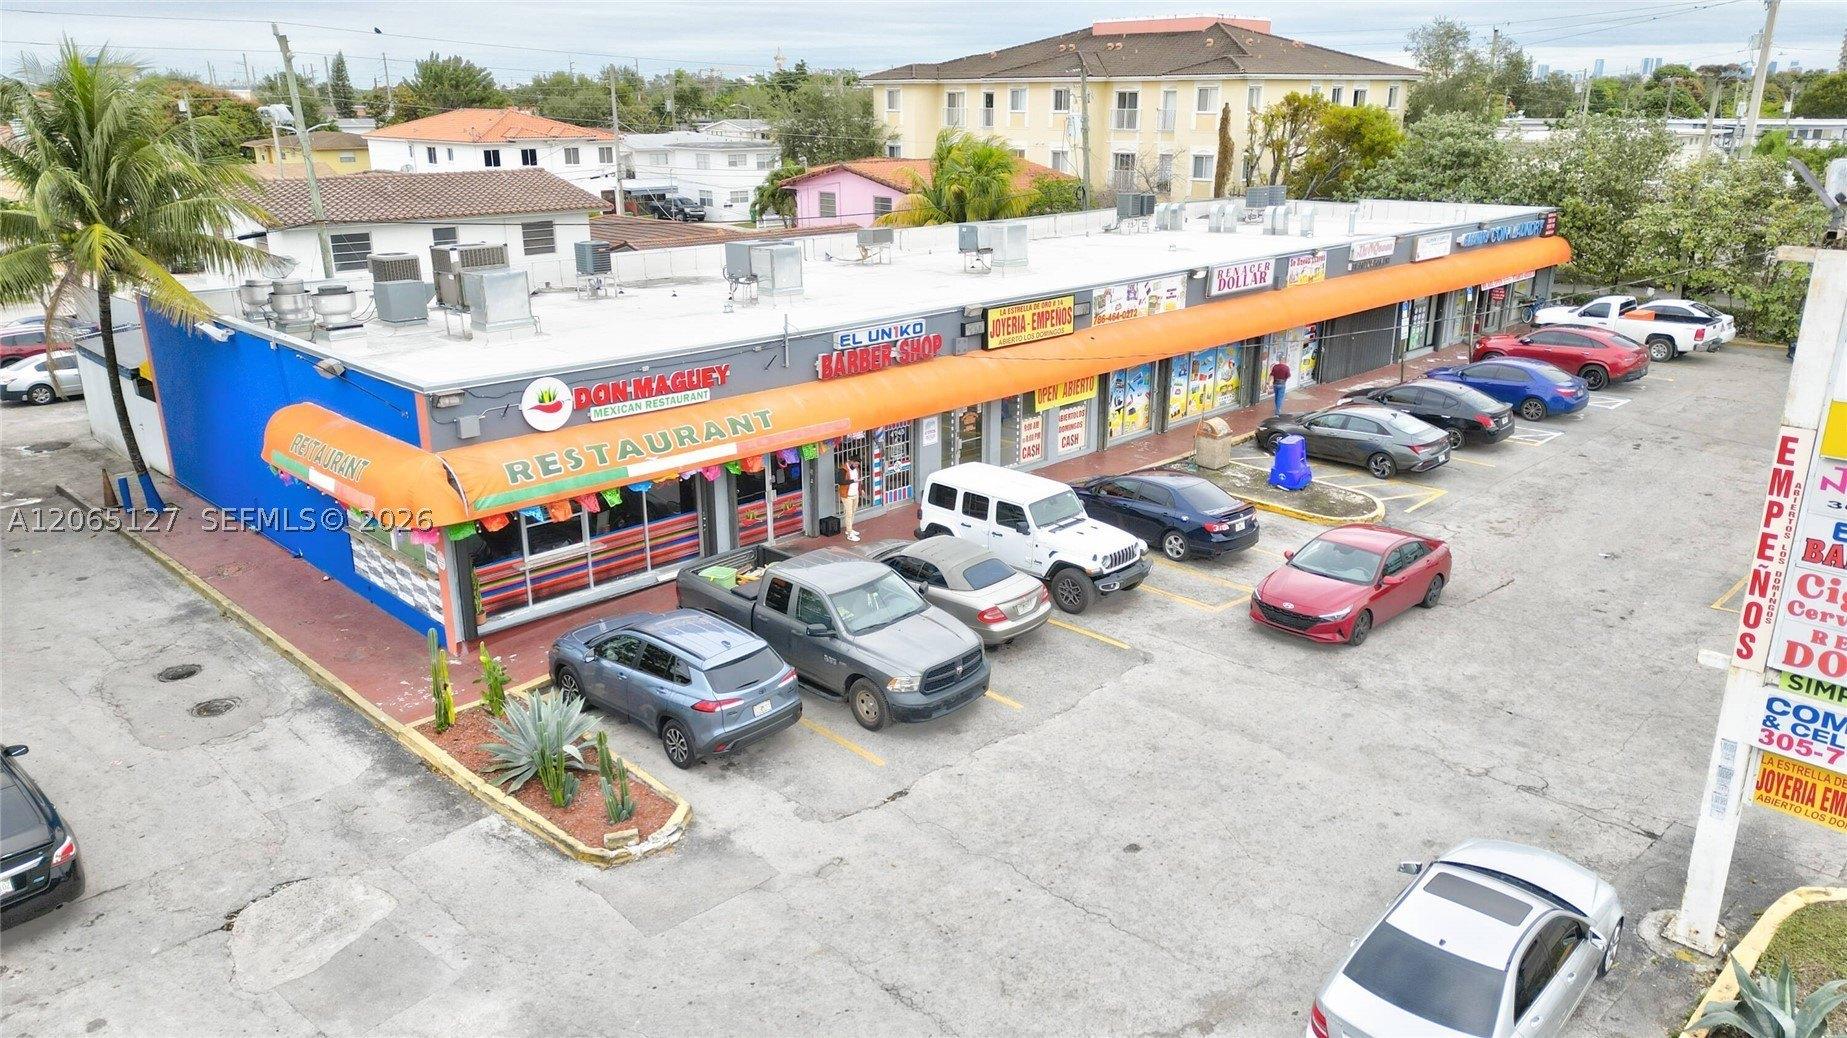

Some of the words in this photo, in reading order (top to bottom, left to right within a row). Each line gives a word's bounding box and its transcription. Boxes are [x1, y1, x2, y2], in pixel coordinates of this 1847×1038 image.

[1217, 261, 1271, 279] RENACER
[1217, 271, 1267, 291] DOLLAR
[990, 314, 1026, 338] JOYERIA
[1031, 306, 1073, 331] EMPEÑOS
[1000, 308, 1007, 316] LA
[1008, 304, 1032, 314] ESTRELLA
[1033, 302, 1041, 311] DE
[1042, 300, 1051, 309] ORO
[839, 333, 863, 348] EL
[998, 334, 1023, 346] ABIERTO
[1024, 332, 1035, 341] LOS
[1036, 328, 1065, 338] DOMINGOS
[818, 343, 892, 380] BARBER
[896, 333, 943, 365] SHOP
[572, 381, 629, 411] DON
[631, 364, 731, 399] MAGUEY
[593, 399, 642, 419] MEXICAN
[645, 389, 709, 410] RESTAURANT
[1037, 384, 1059, 405] OPEN
[1062, 376, 1095, 398] ABIERTO
[288, 431, 371, 483] RESTAURANT
[504, 409, 774, 486] RESTAURANT
[1022, 444, 1041, 459] CASH
[1061, 433, 1080, 449] CASH
[1784, 482, 1802, 540] ABIERTOS
[1736, 434, 1800, 660] EMPEÑOS
[1778, 544, 1788, 565] LOS
[1801, 537, 1847, 570] BA
[1765, 570, 1783, 625] DOMINGOS
[1782, 640, 1847, 678] DO
[1762, 714, 1780, 731] &
[1790, 722, 1846, 749] CEL
[1765, 697, 1847, 735] COM
[1755, 767, 1818, 808] JOYERIA
[1761, 755, 1775, 767] LA
[1777, 760, 1831, 784] ESTRELLA
[1833, 777, 1847, 789] DE
[1756, 794, 1803, 815] ABIERTO
[1804, 808, 1827, 822] LOS
